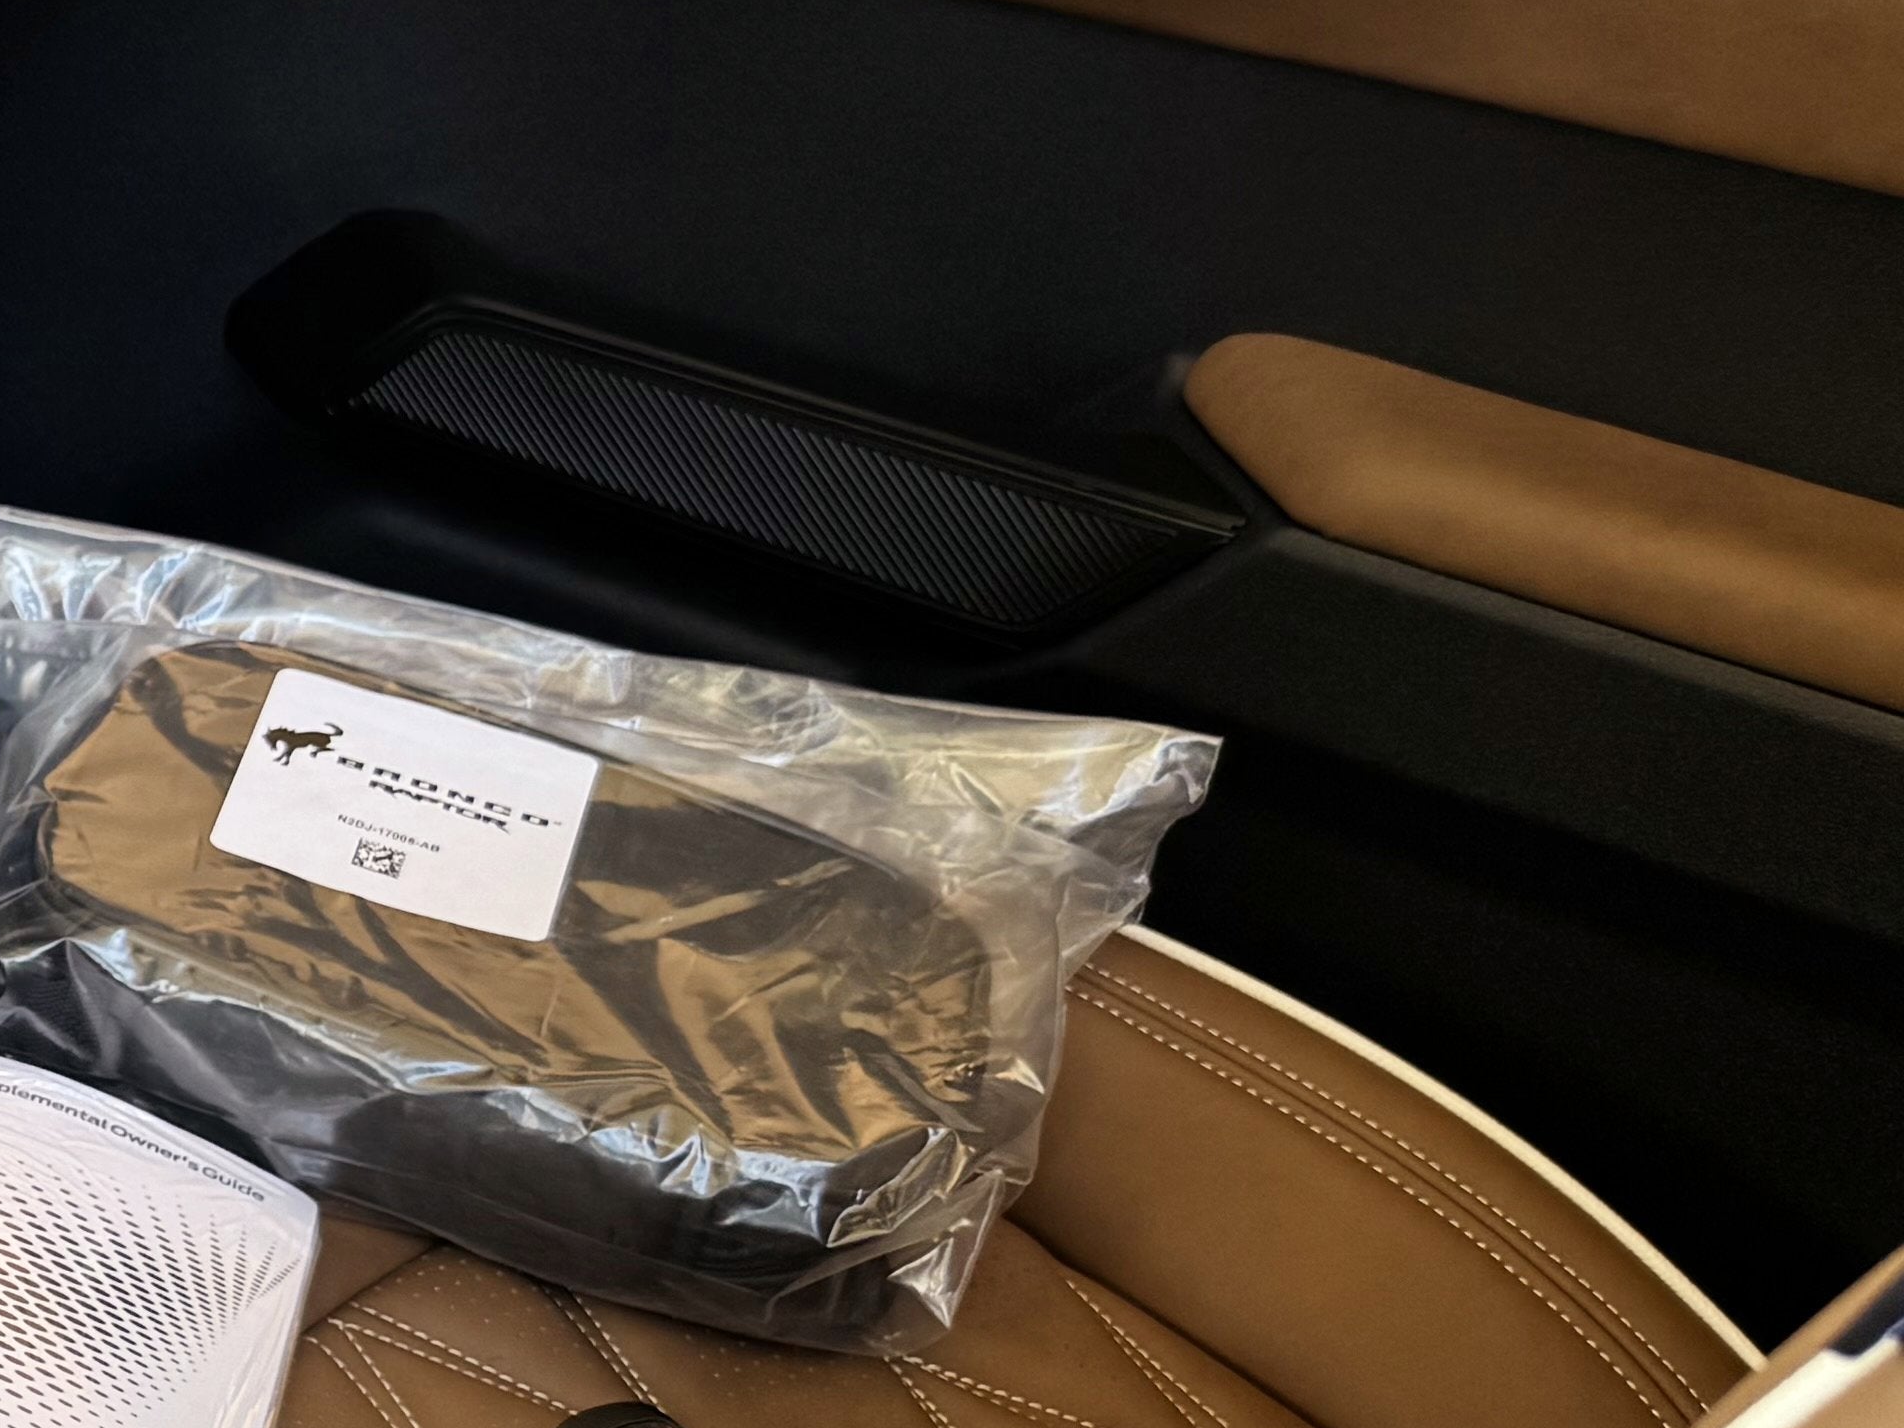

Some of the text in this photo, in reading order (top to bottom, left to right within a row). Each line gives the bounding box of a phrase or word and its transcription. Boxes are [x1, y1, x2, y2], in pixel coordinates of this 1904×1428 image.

[336, 755, 550, 828] BRONCO
[369, 779, 511, 836] RAPTOR
[109, 1123, 200, 1173] Owner's
[201, 1165, 267, 1204] Guide
